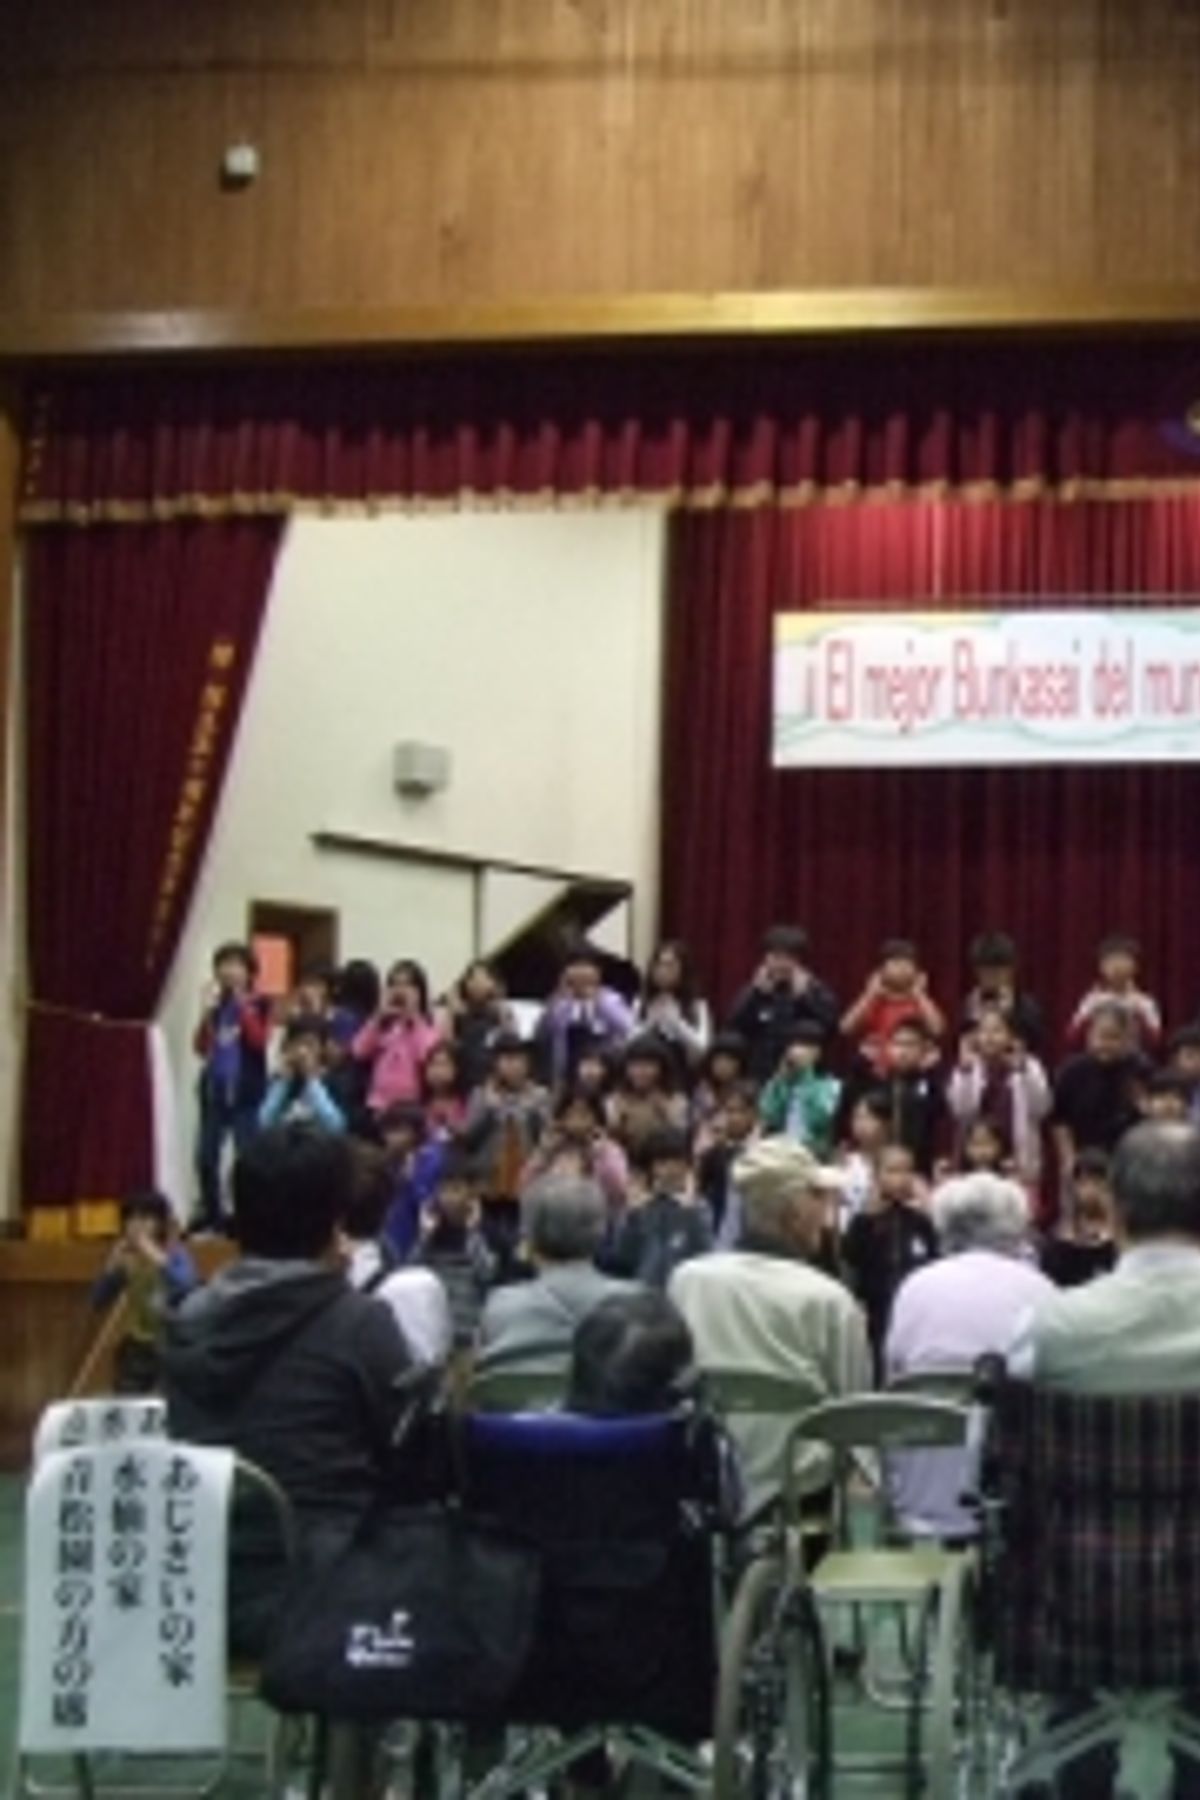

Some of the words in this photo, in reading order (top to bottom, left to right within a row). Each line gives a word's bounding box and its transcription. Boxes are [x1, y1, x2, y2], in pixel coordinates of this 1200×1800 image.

[825, 639, 853, 720] El
[865, 639, 941, 735] mejor
[954, 638, 1079, 720] Bunkasai
[1093, 638, 1133, 718] del
